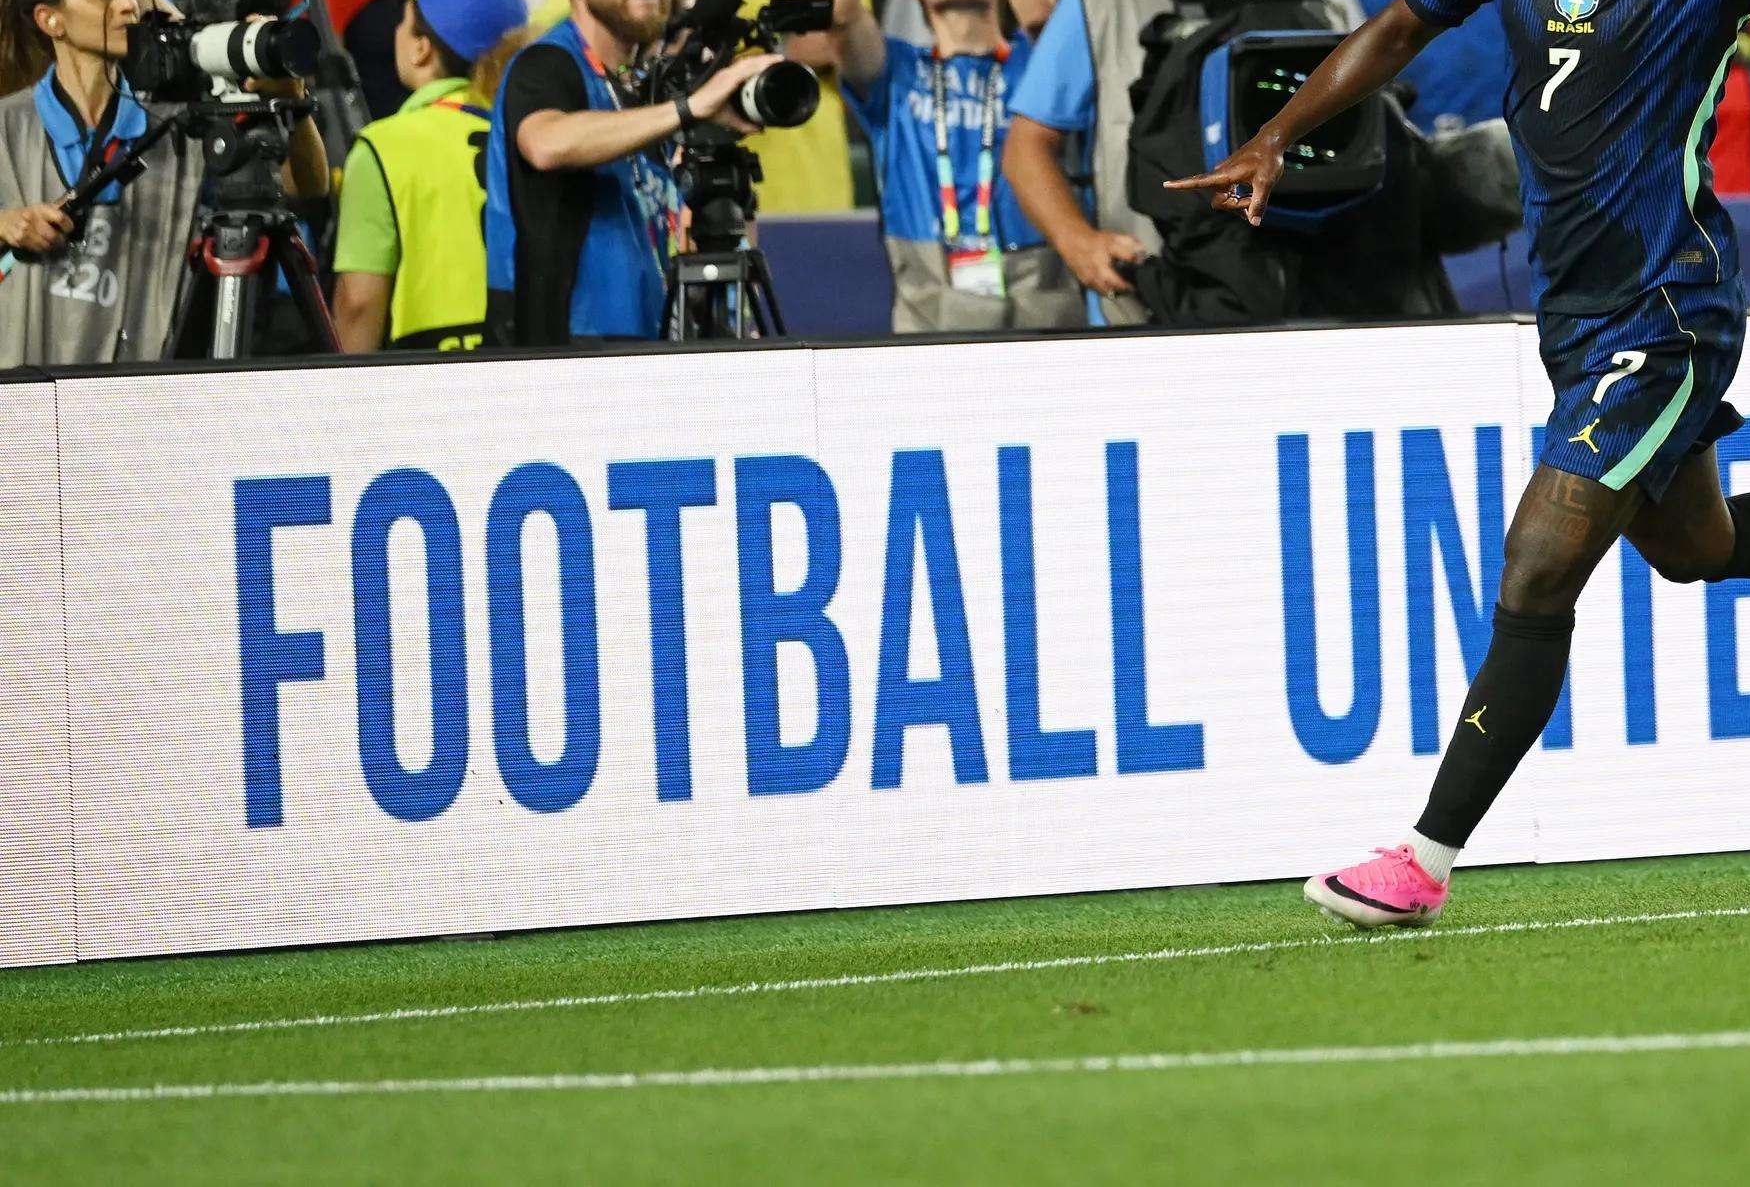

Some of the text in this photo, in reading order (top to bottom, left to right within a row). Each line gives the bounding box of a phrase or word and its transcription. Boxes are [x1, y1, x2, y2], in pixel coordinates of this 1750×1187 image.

[1546, 19, 1595, 34] BRASIL
[1539, 47, 1581, 113] 7
[49, 261, 118, 307] 220
[1592, 350, 1647, 405] 7
[233, 440, 1205, 830] FOOTBALL
